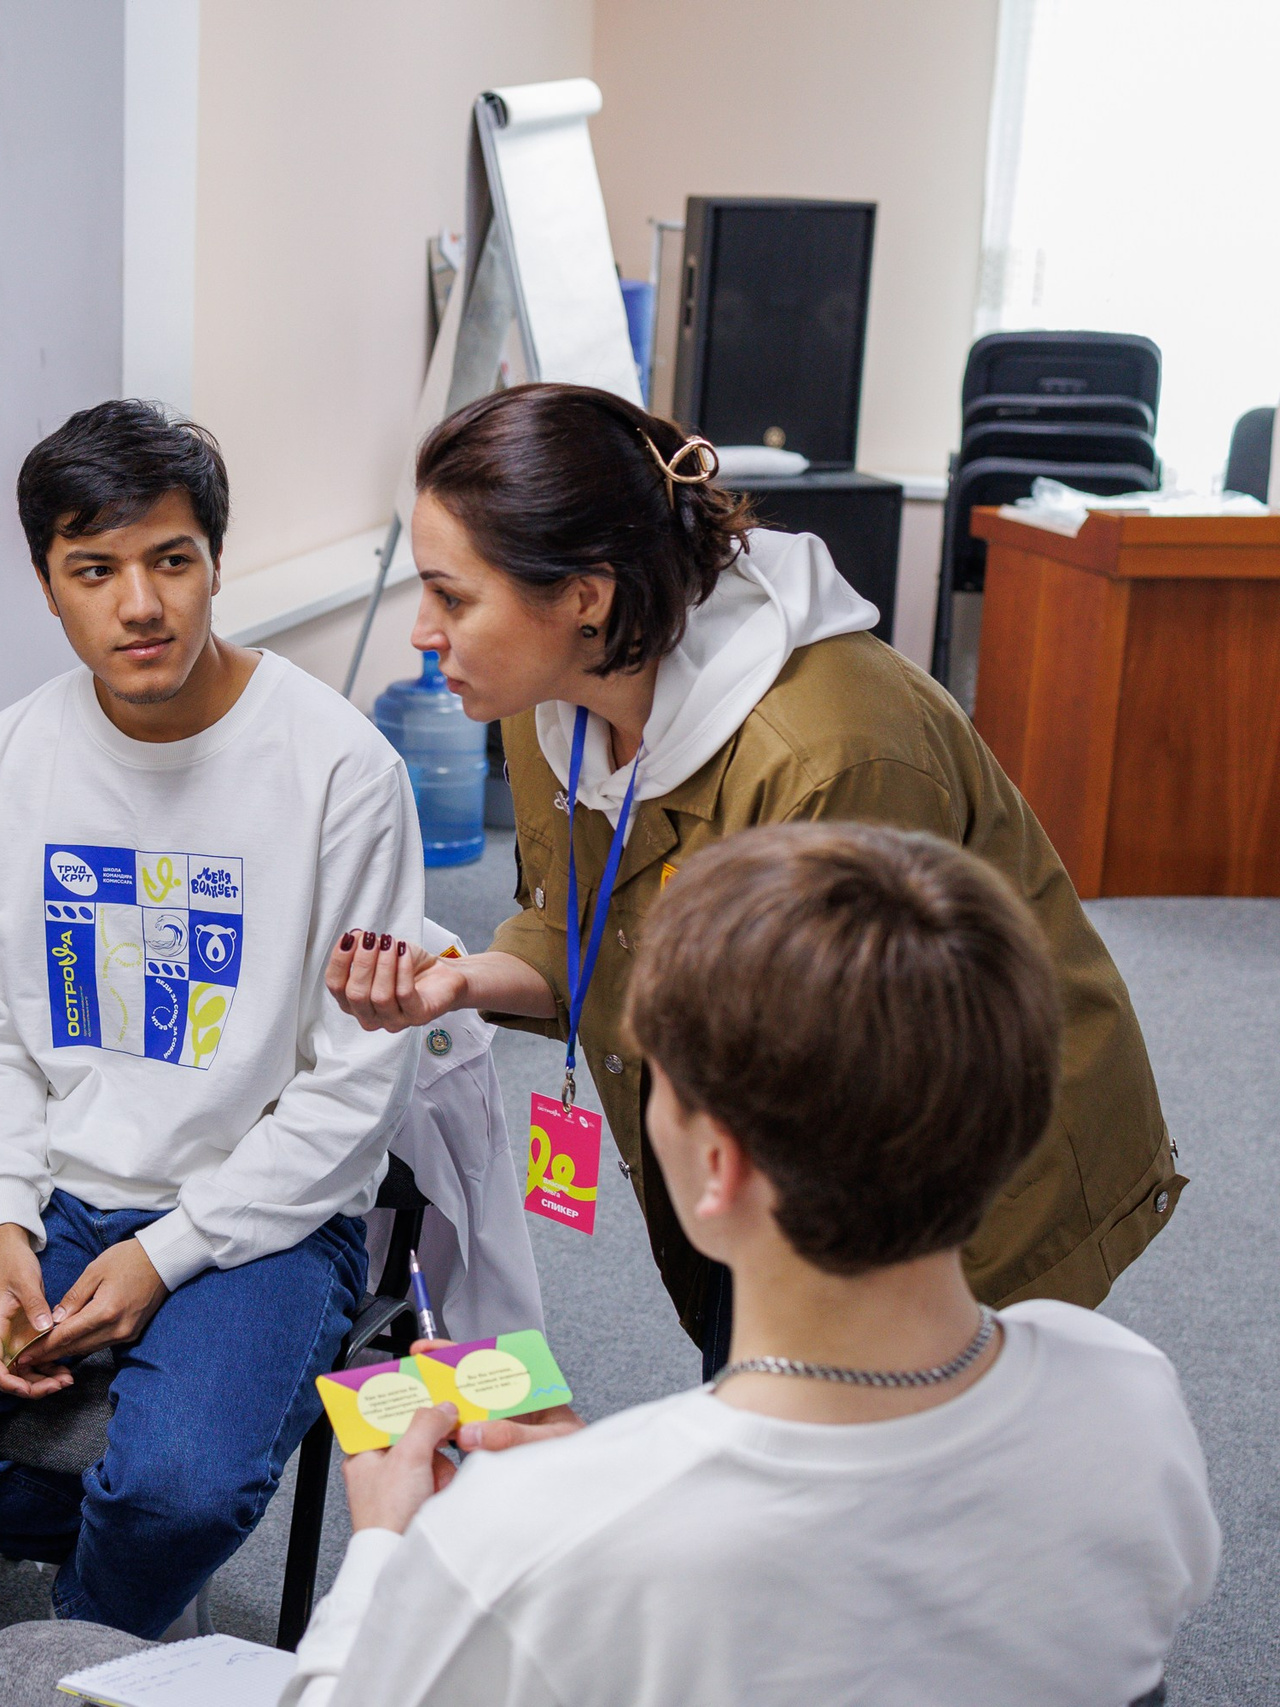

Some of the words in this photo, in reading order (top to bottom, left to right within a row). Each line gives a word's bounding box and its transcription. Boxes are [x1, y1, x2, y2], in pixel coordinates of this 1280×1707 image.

[57, 865, 87, 874] ТРУД
[102, 872, 133, 880] КОМАНДИРА
[196, 866, 232, 885] МЕНЯ
[61, 873, 93, 883] КРУТ
[190, 878, 239, 899] ВОЛНУЕТ
[155, 977, 173, 994] ВЕДИ
[170, 993, 178, 1004] ЗА
[167, 1004, 179, 1029] СОБОЙ
[173, 1025, 178, 1036] ЗА
[541, 1198, 579, 1218] СПИКЕР
